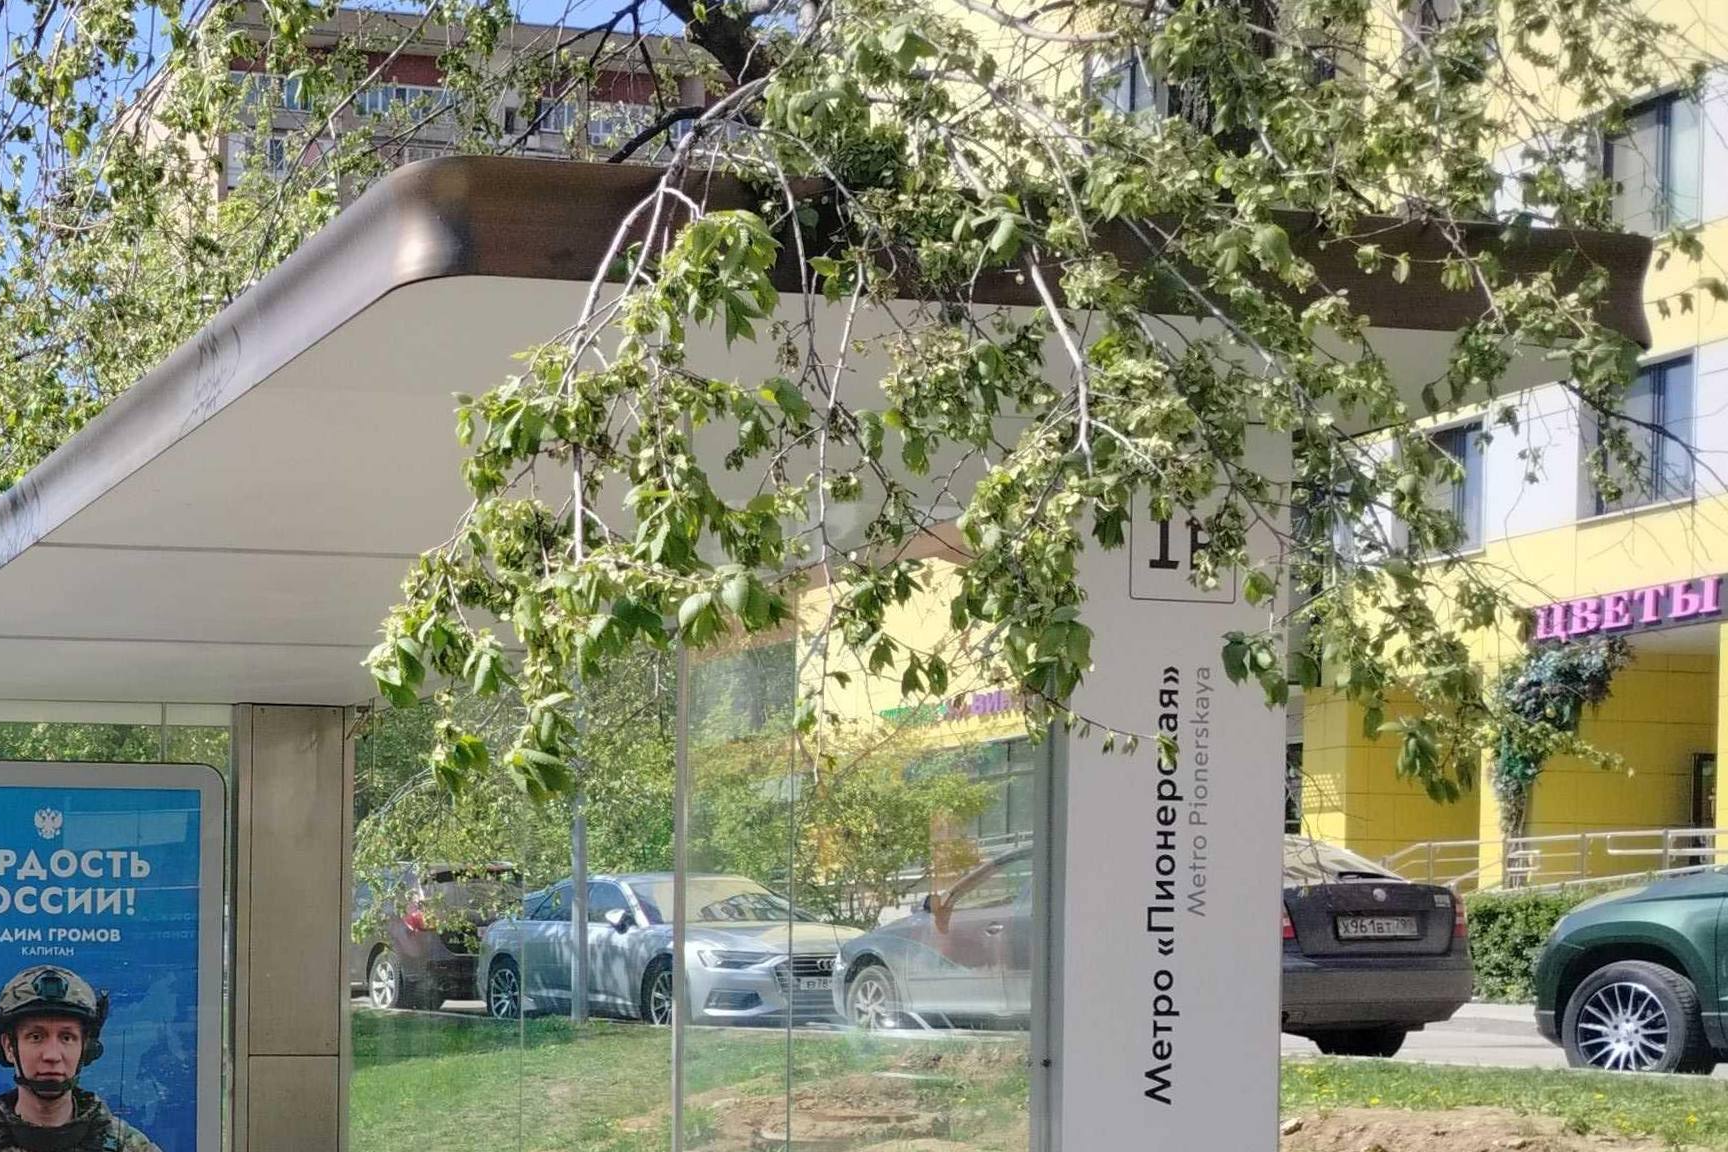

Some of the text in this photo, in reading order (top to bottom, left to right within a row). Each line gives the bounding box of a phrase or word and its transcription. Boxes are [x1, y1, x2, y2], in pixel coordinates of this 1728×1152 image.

[1534, 575, 1722, 643] ЦВЕТЫ
[1187, 667, 1214, 917] Metro Pionerskaya
[1144, 666, 1184, 1105] Метро «Пионерсая»
[21, 946, 74, 956] КАПИТАН
[48, 928, 121, 942] ГРОМОВ
